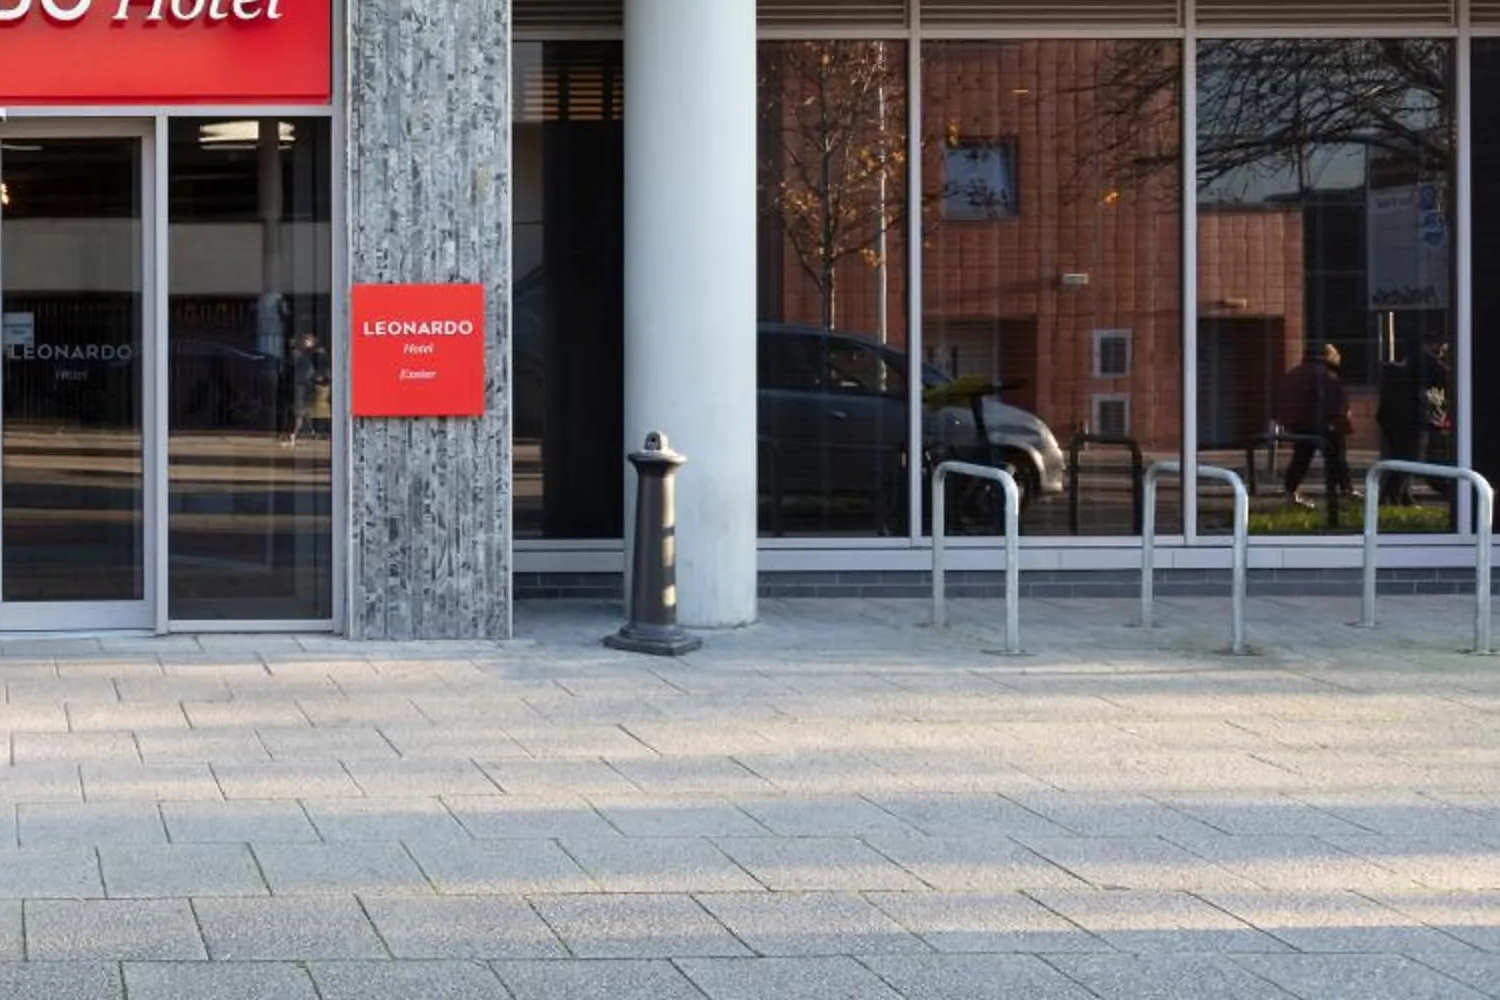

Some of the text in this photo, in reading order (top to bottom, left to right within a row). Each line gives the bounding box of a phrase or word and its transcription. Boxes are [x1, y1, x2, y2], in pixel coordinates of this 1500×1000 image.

[363, 321, 474, 336] LEONARDO
[10, 344, 133, 360] LEONARDO
[403, 343, 435, 354] Hotel
